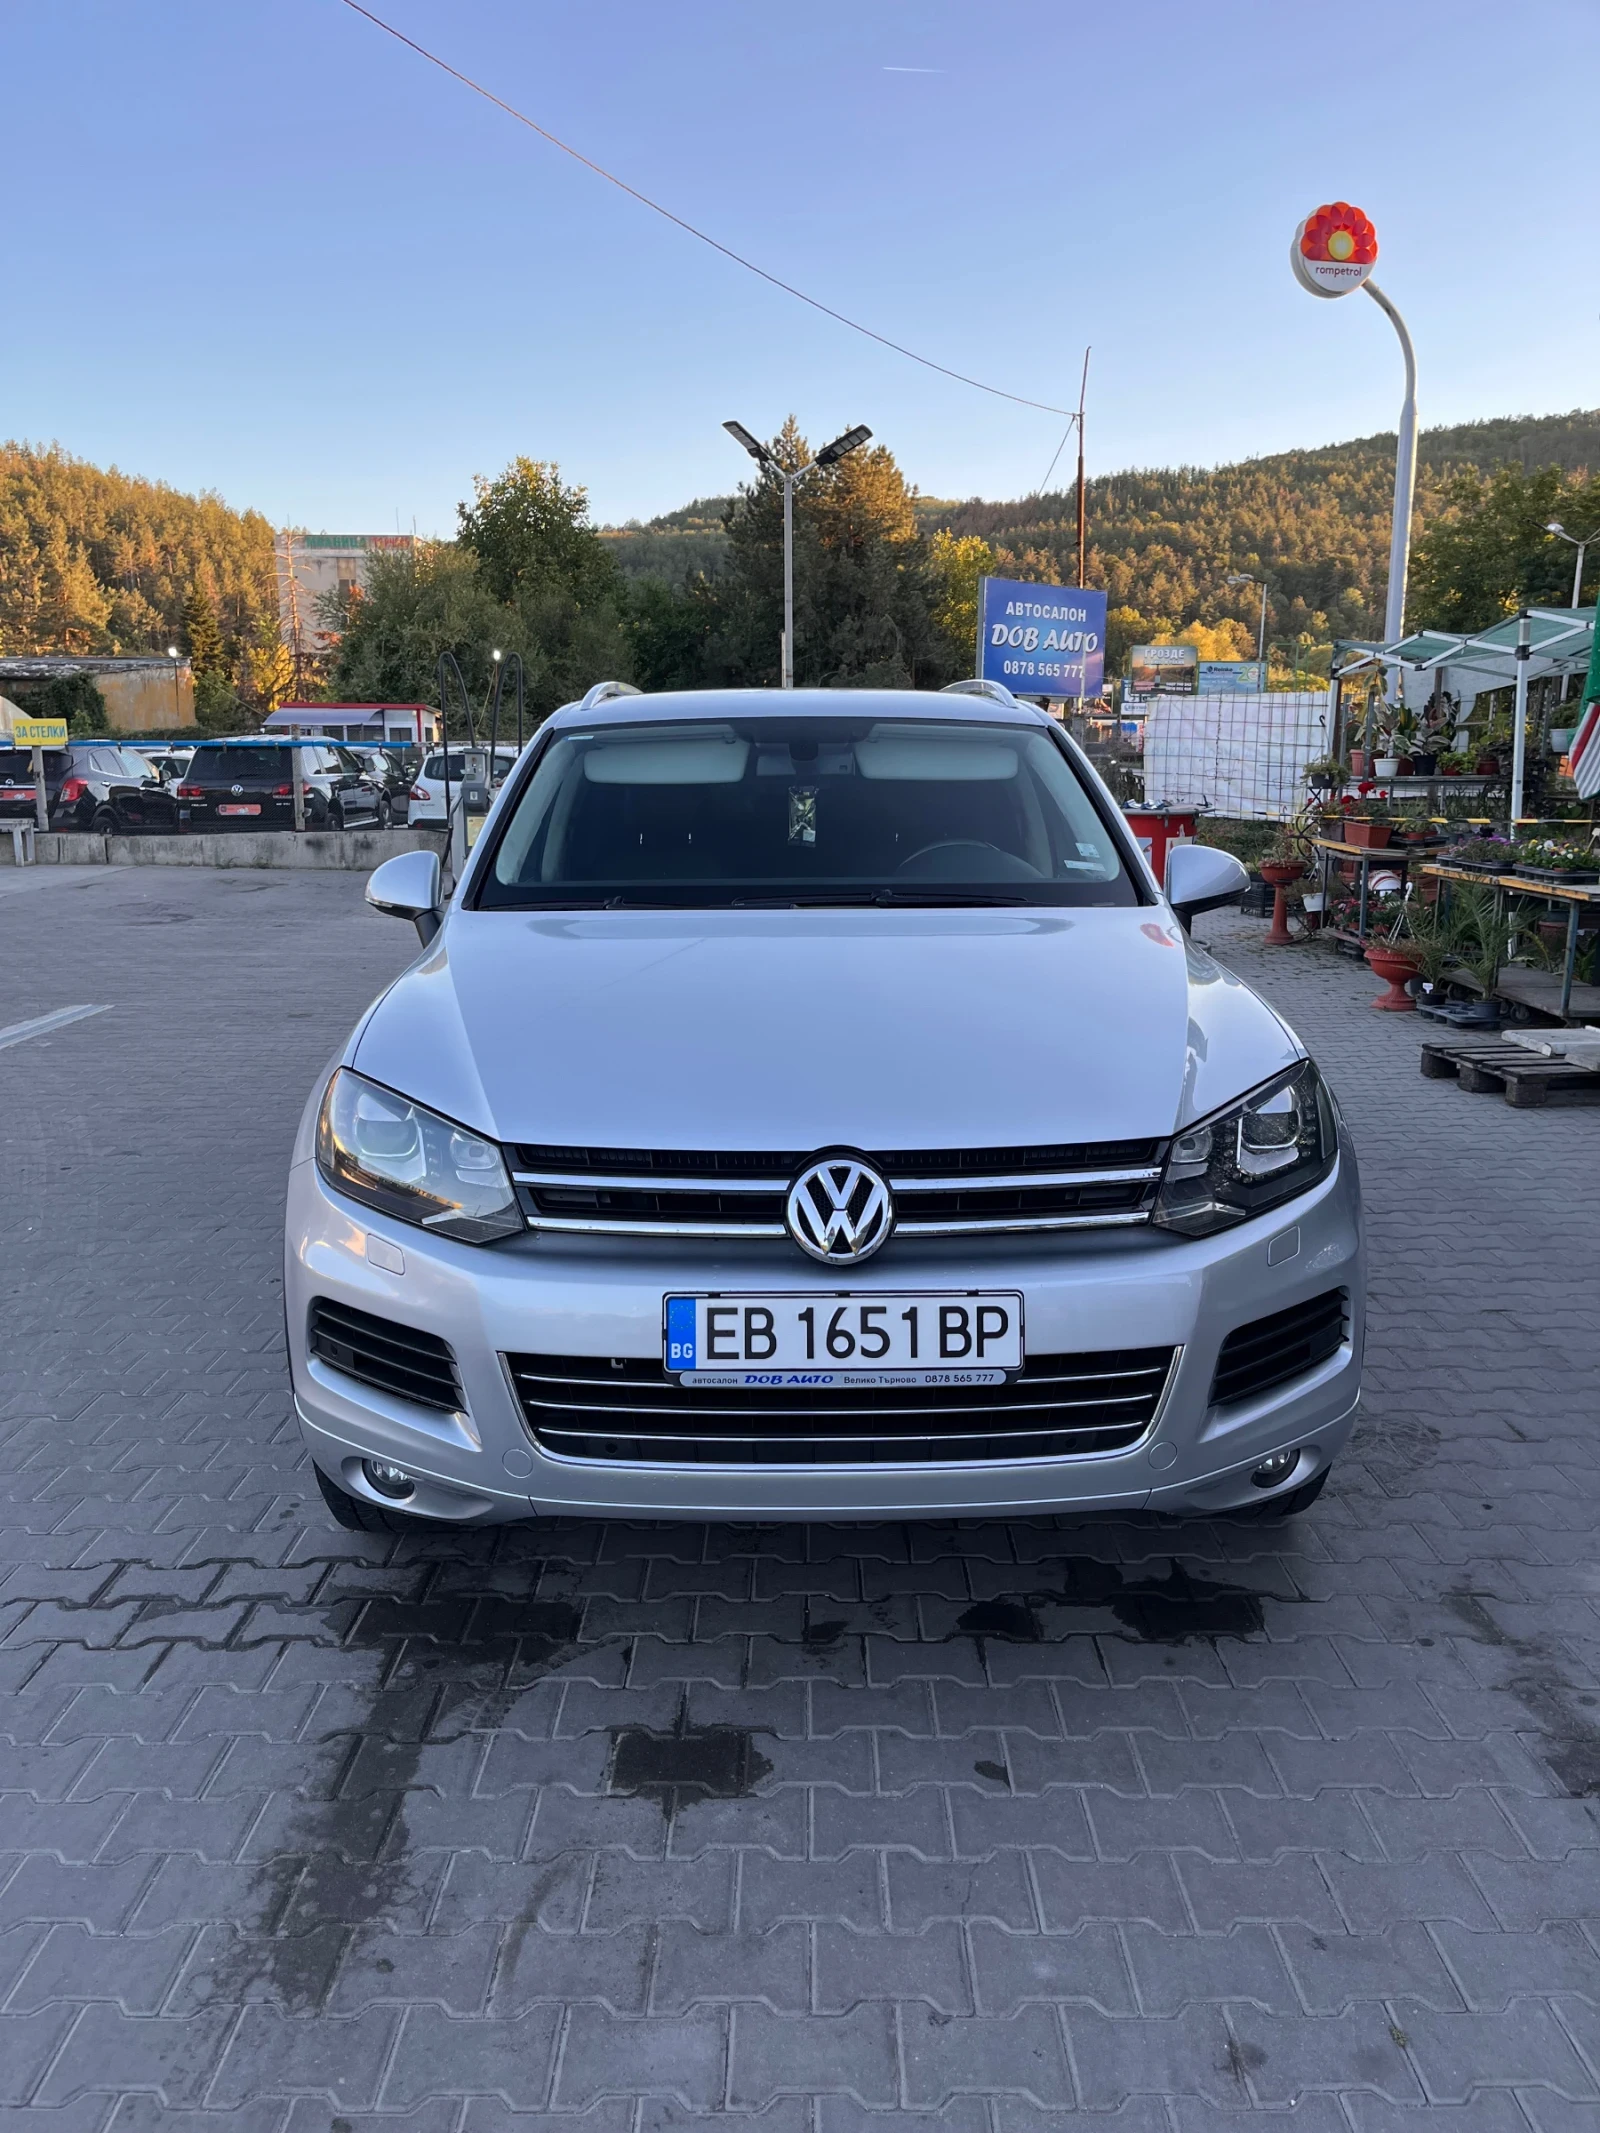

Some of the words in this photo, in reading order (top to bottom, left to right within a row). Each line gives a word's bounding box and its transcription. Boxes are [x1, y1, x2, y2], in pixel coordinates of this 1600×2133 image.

[1315, 266, 1362, 278] rompetrol
[1005, 601, 1087, 622] АВТОСАЛОН
[991, 623, 1040, 652] DOB
[1042, 628, 1098, 653] AUTO
[1144, 649, 1185, 660] ГРОЗДЕ
[1003, 660, 1035, 676] 0878
[1037, 662, 1061, 677] 565
[1063, 664, 1084, 678] 777
[15, 725, 28, 738] ЗА
[30, 725, 66, 738] СТЕЛКИ
[706, 1306, 777, 1360] EB
[797, 1306, 918, 1360] 1651
[939, 1305, 1009, 1359] BP
[670, 1342, 693, 1360] BG
[692, 1376, 738, 1385] автосалон
[744, 1374, 783, 1385] DOB
[786, 1374, 834, 1384] AUTO
[843, 1376, 877, 1384] Велико
[878, 1376, 917, 1384] Търново
[924, 1374, 951, 1383] 0878
[953, 1374, 972, 1383] 565
[975, 1373, 995, 1382] 777
